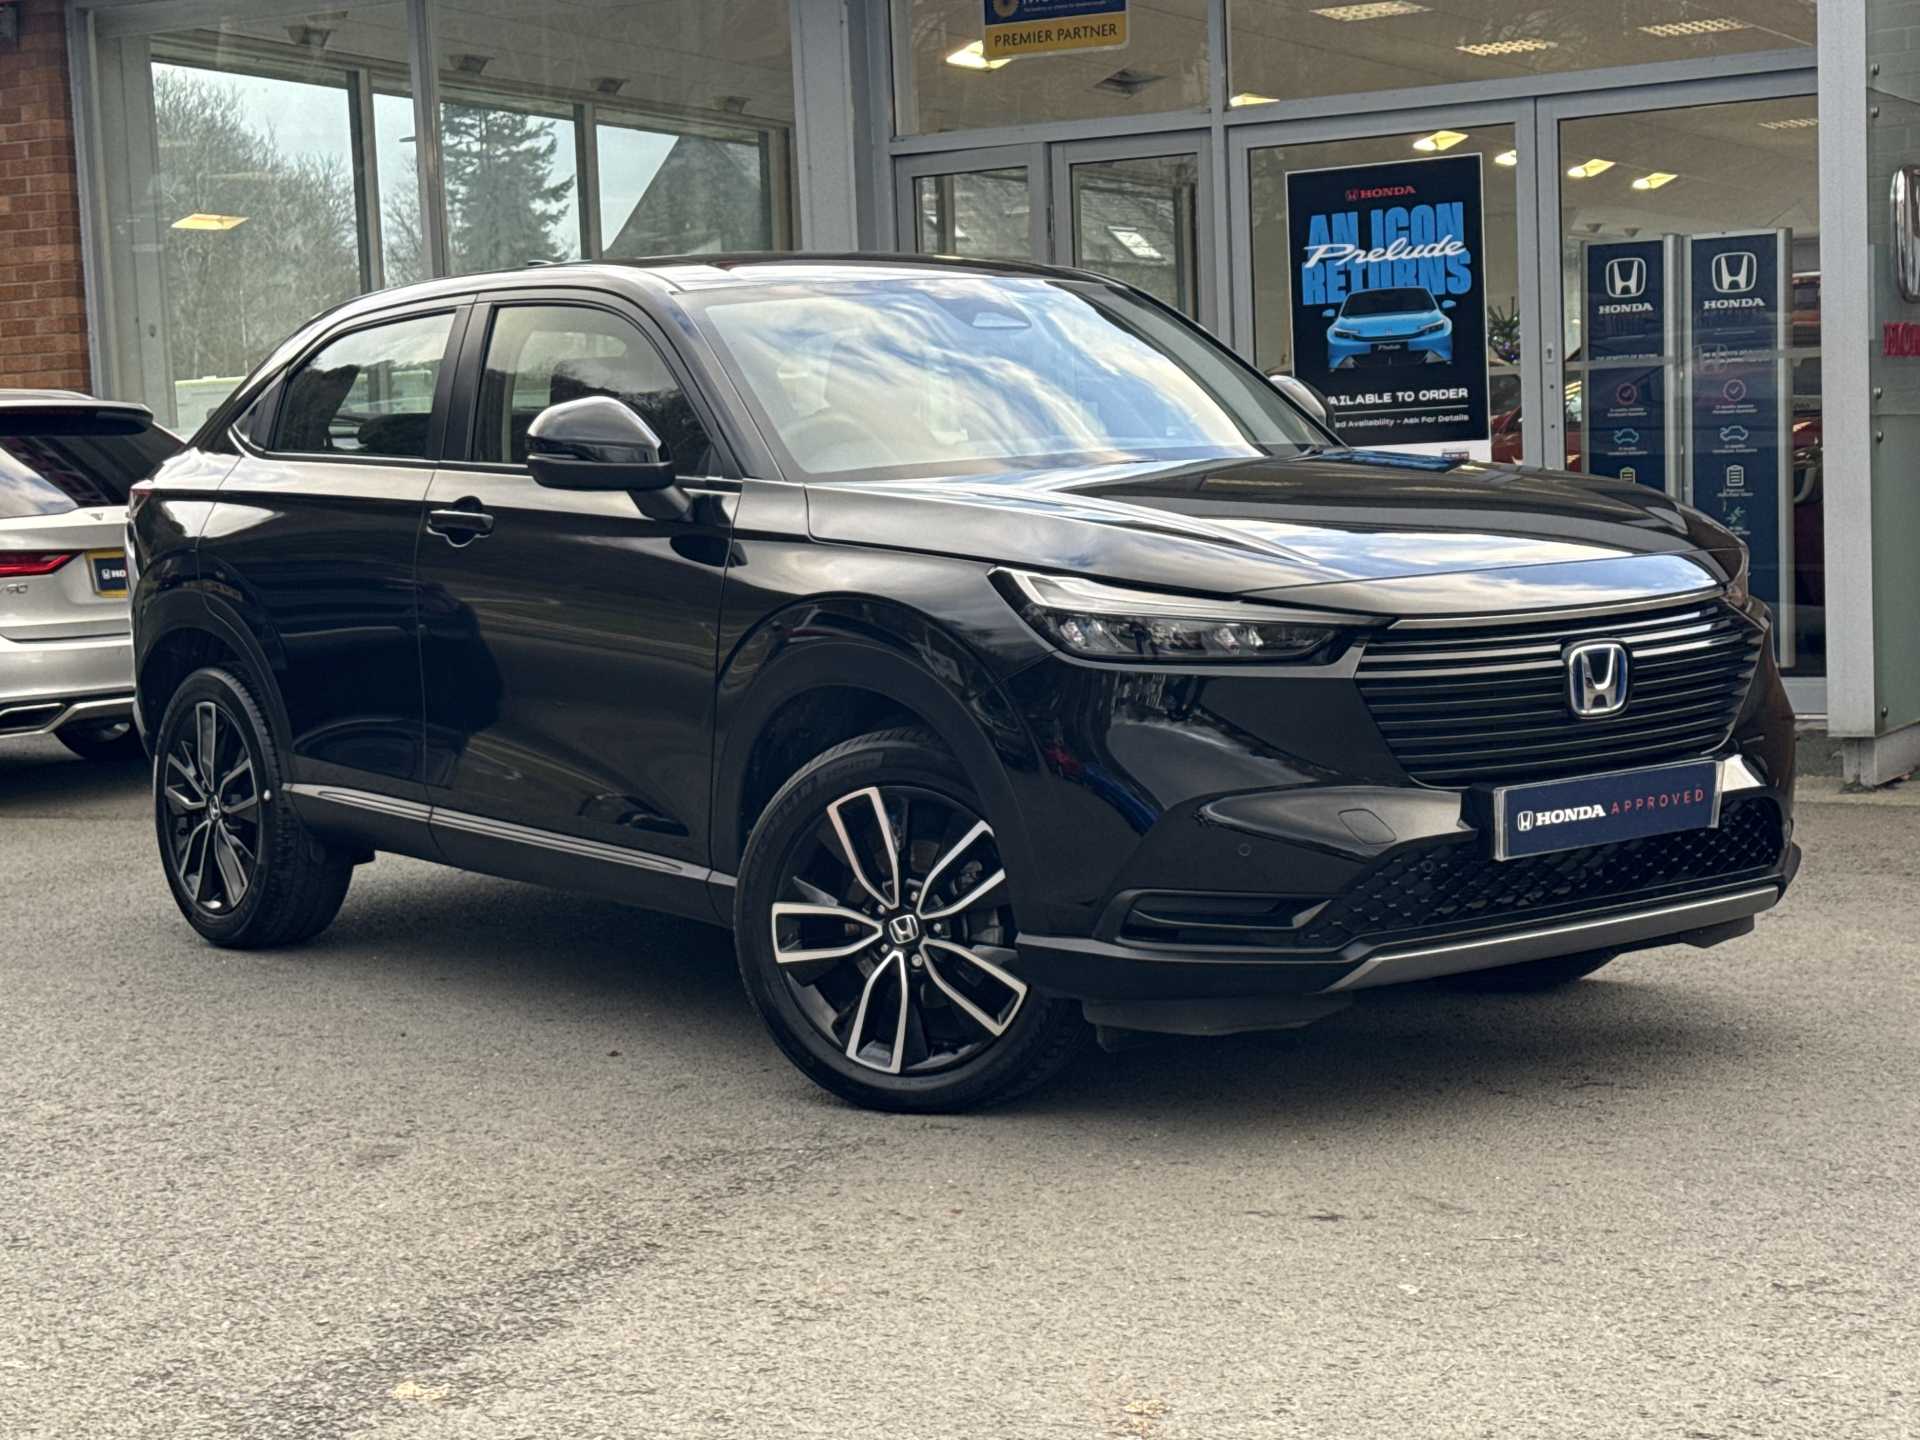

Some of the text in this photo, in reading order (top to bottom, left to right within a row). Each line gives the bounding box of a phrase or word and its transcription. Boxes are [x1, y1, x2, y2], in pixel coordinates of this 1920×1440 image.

[994, 23, 1117, 47] PREMIER PARTNER
[1360, 185, 1416, 199] HONDA
[1307, 201, 1464, 260] AN ICON
[1303, 234, 1467, 269] Prelude
[1302, 252, 1472, 305] RETURNS
[1598, 302, 1654, 315] HONDA
[1703, 297, 1766, 310] HONDA
[1396, 391, 1415, 402] TO
[1419, 388, 1469, 400] ORDER
[1348, 418, 1394, 428] Availability
[1438, 414, 1470, 422] Details
[1535, 788, 1704, 826] HONDA APPROVED
